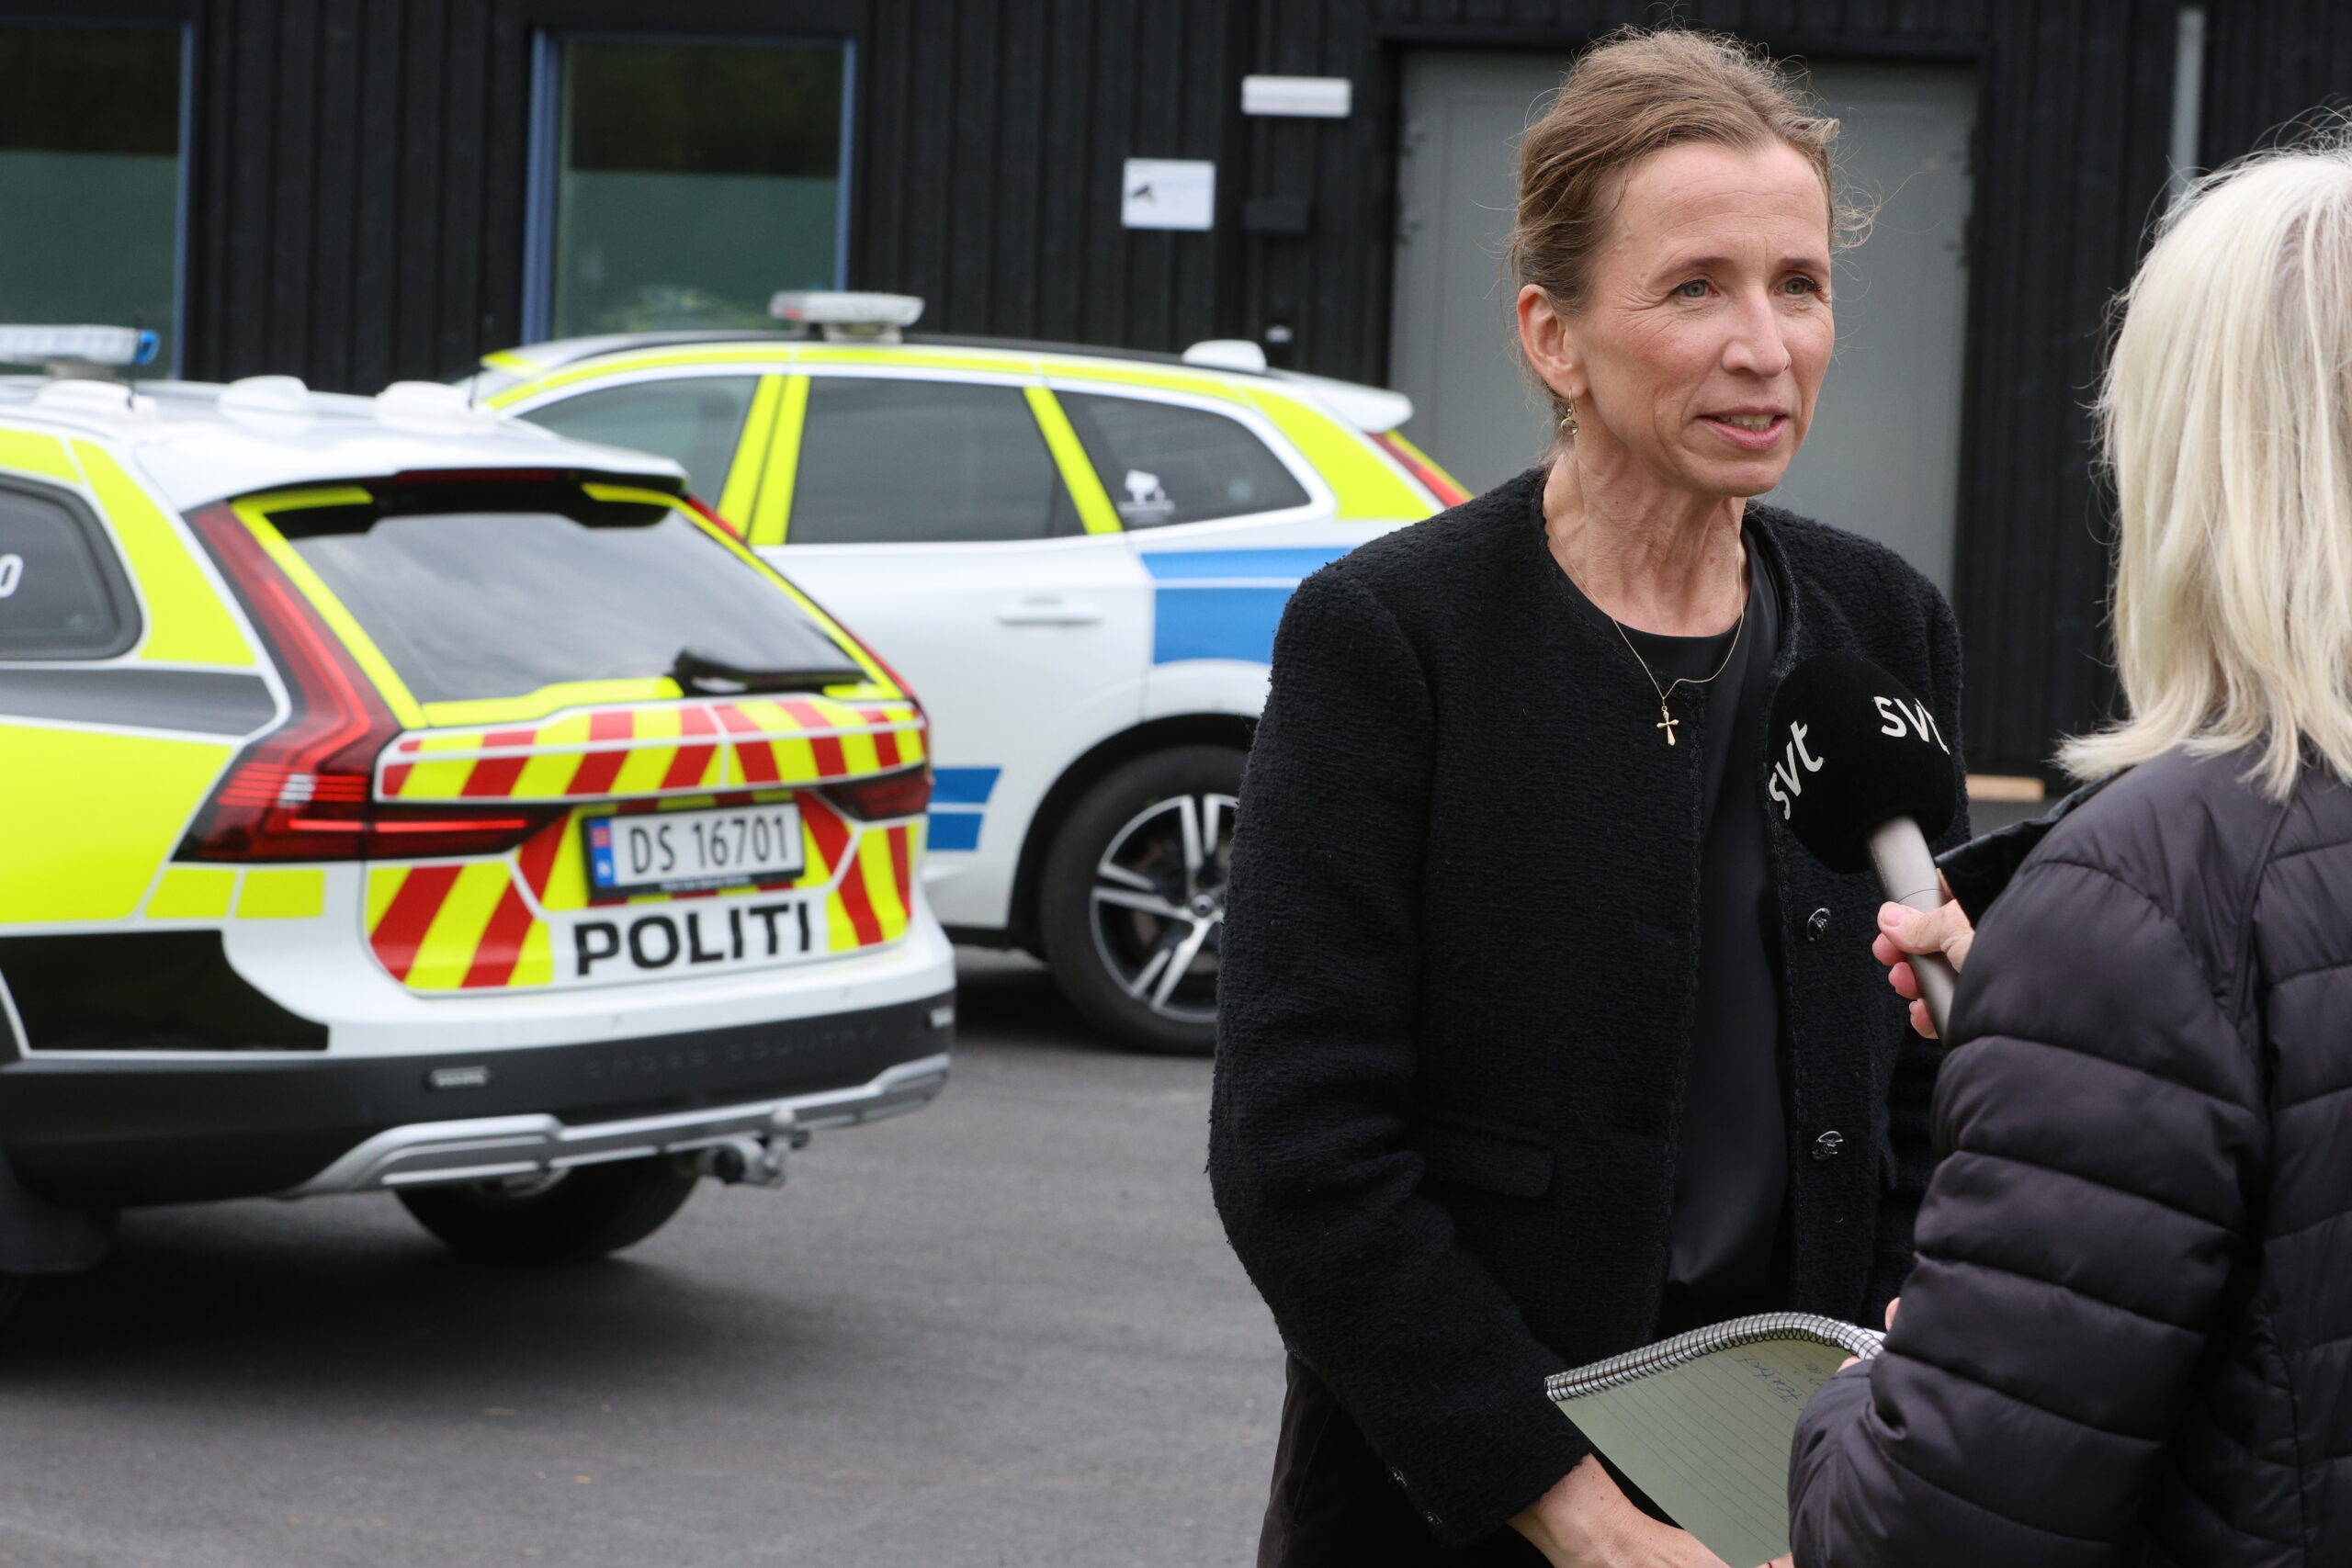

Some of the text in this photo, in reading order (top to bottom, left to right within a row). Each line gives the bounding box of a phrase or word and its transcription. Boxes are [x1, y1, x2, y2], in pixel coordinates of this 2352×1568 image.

[629, 815, 787, 874] DS 16701
[573, 901, 810, 976] POLITI
